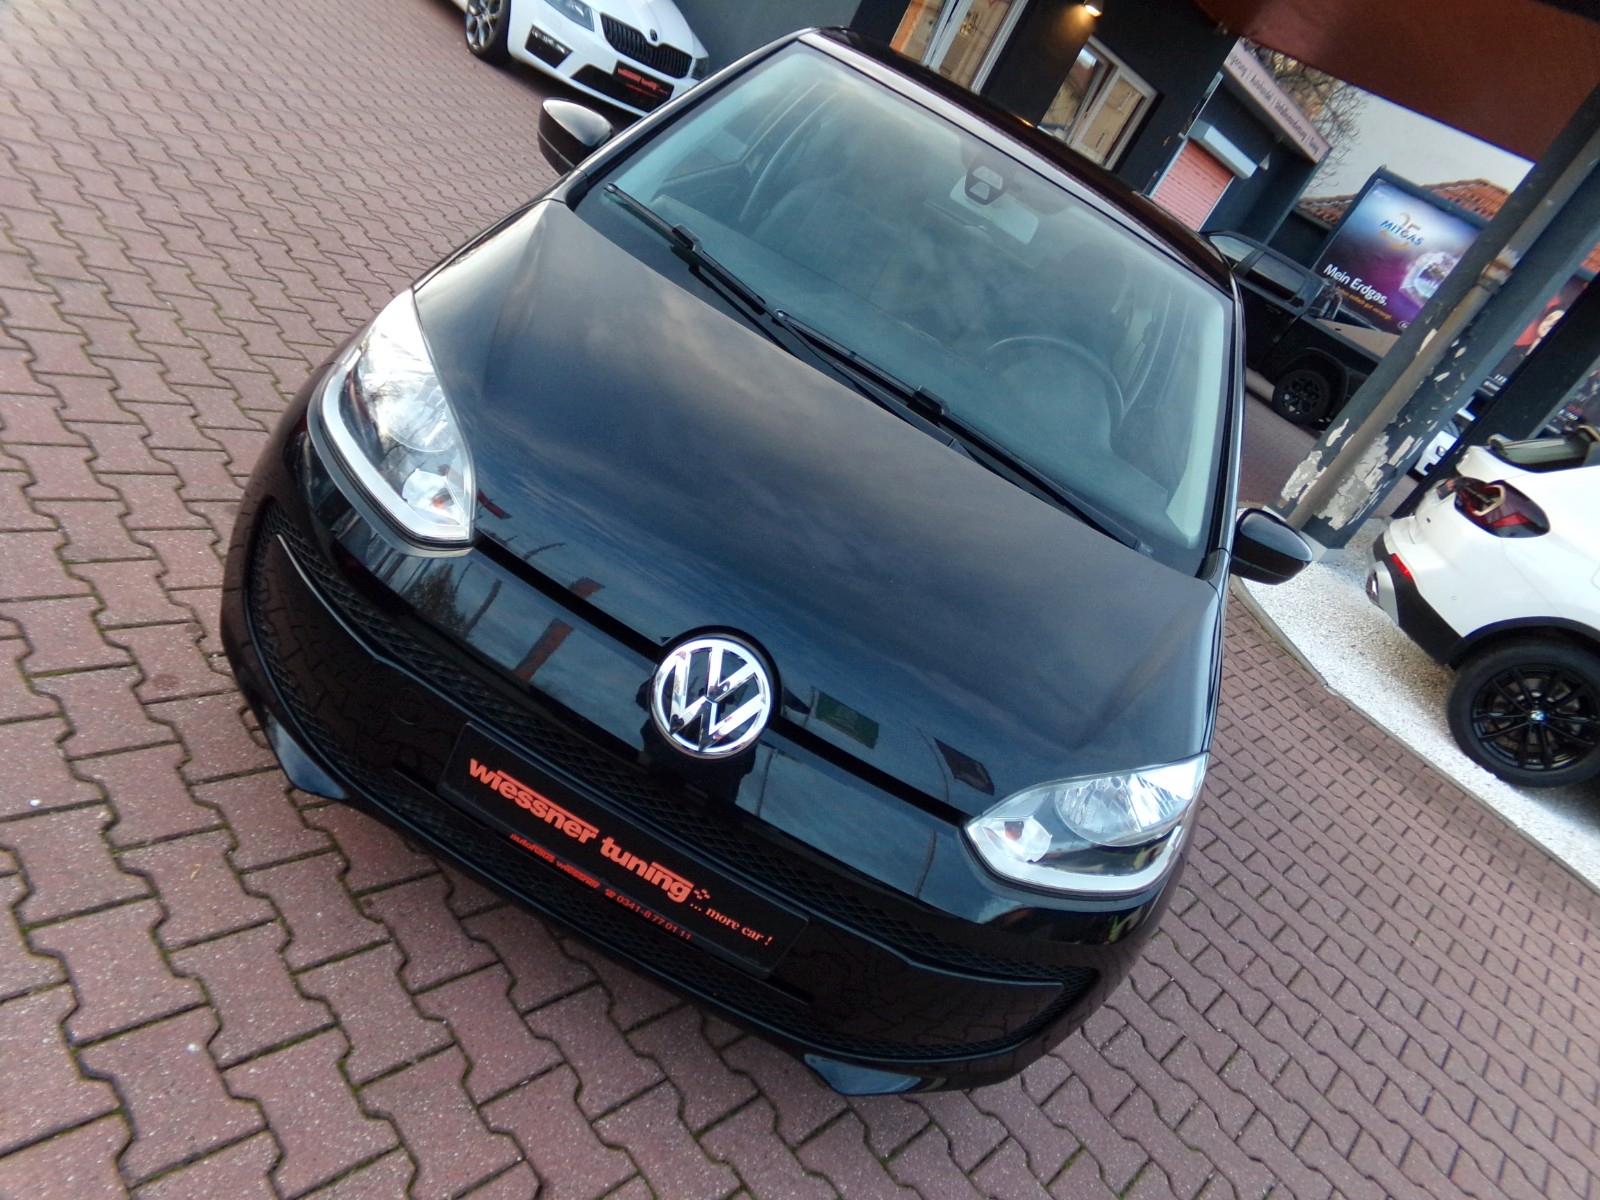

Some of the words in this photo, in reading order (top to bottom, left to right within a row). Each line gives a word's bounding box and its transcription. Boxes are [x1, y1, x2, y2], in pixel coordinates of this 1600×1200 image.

[1380, 219, 1424, 245] MITGAS
[1323, 263, 1350, 285] Mein
[1350, 277, 1388, 306] Erdgas,
[468, 757, 600, 845] wiessner
[600, 836, 694, 904] tuning
[705, 905, 740, 931] more
[741, 923, 764, 944] car
